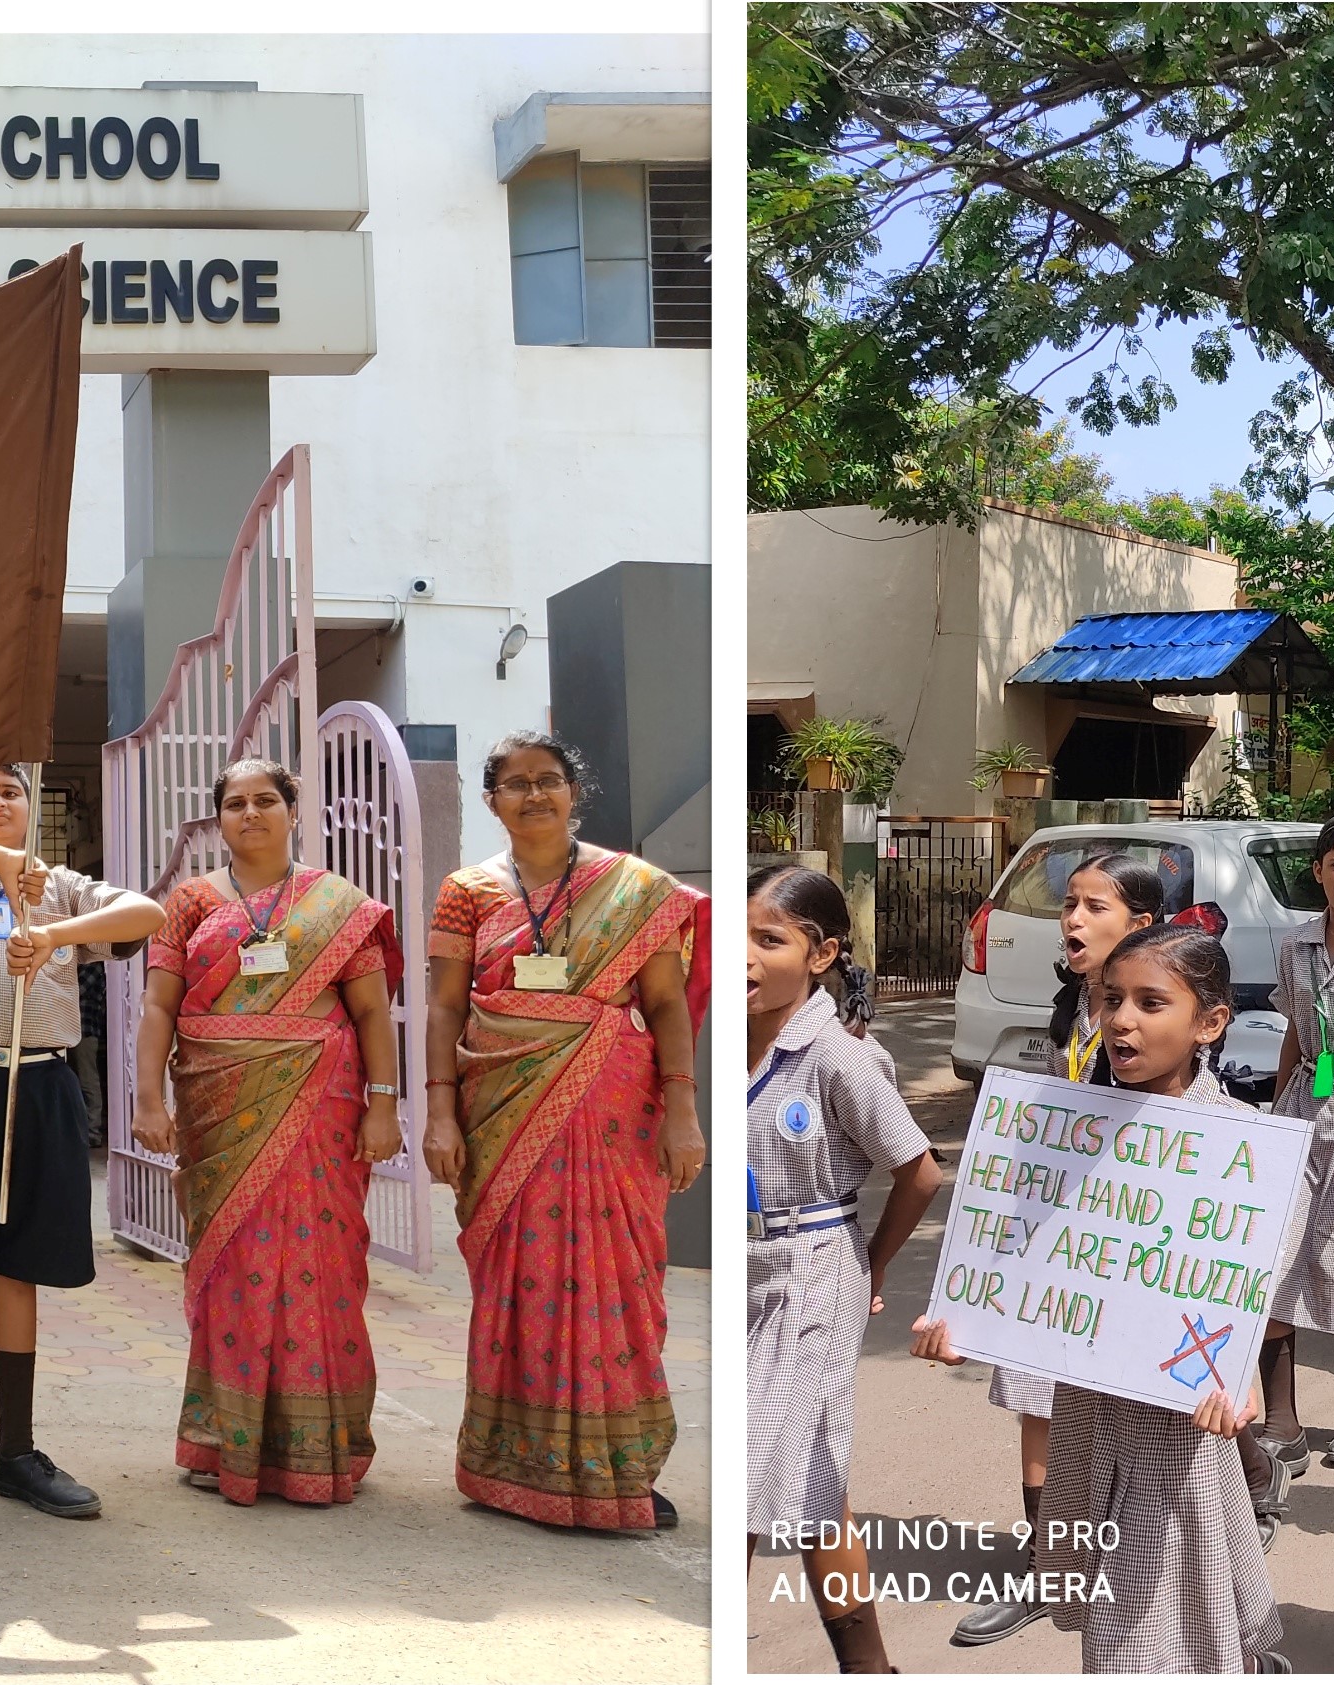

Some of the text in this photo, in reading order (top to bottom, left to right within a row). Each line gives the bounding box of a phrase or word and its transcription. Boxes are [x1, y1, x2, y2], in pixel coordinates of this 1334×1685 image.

[8, 259, 280, 324] IENCE
[980, 1095, 1255, 1183] PLASTICS GIVE A
[969, 1151, 1265, 1246] HELPFUL HAND, BUT
[963, 1205, 1273, 1314] THEY ARE POLLUTING
[945, 1263, 1105, 1347] OUR LAND!
